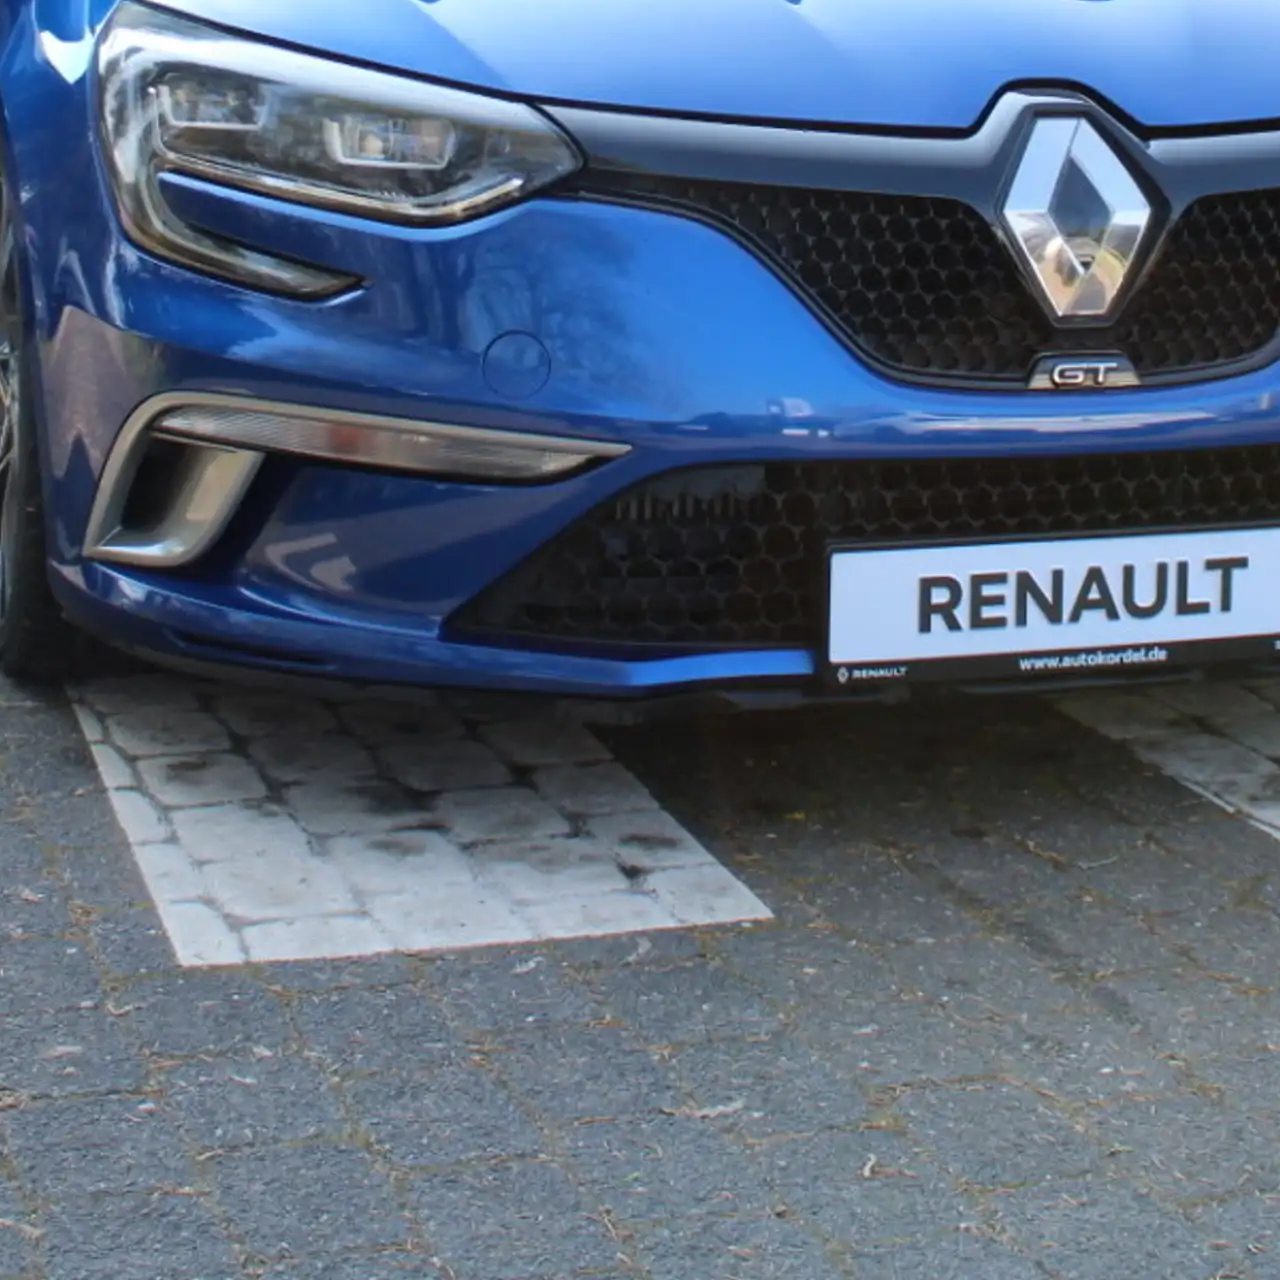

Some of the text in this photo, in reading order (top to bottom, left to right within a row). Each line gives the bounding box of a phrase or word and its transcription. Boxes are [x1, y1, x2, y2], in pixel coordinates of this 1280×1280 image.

[1053, 362, 1118, 384] GT
[917, 556, 1249, 634] RENAULT
[851, 665, 908, 680] RENAULT
